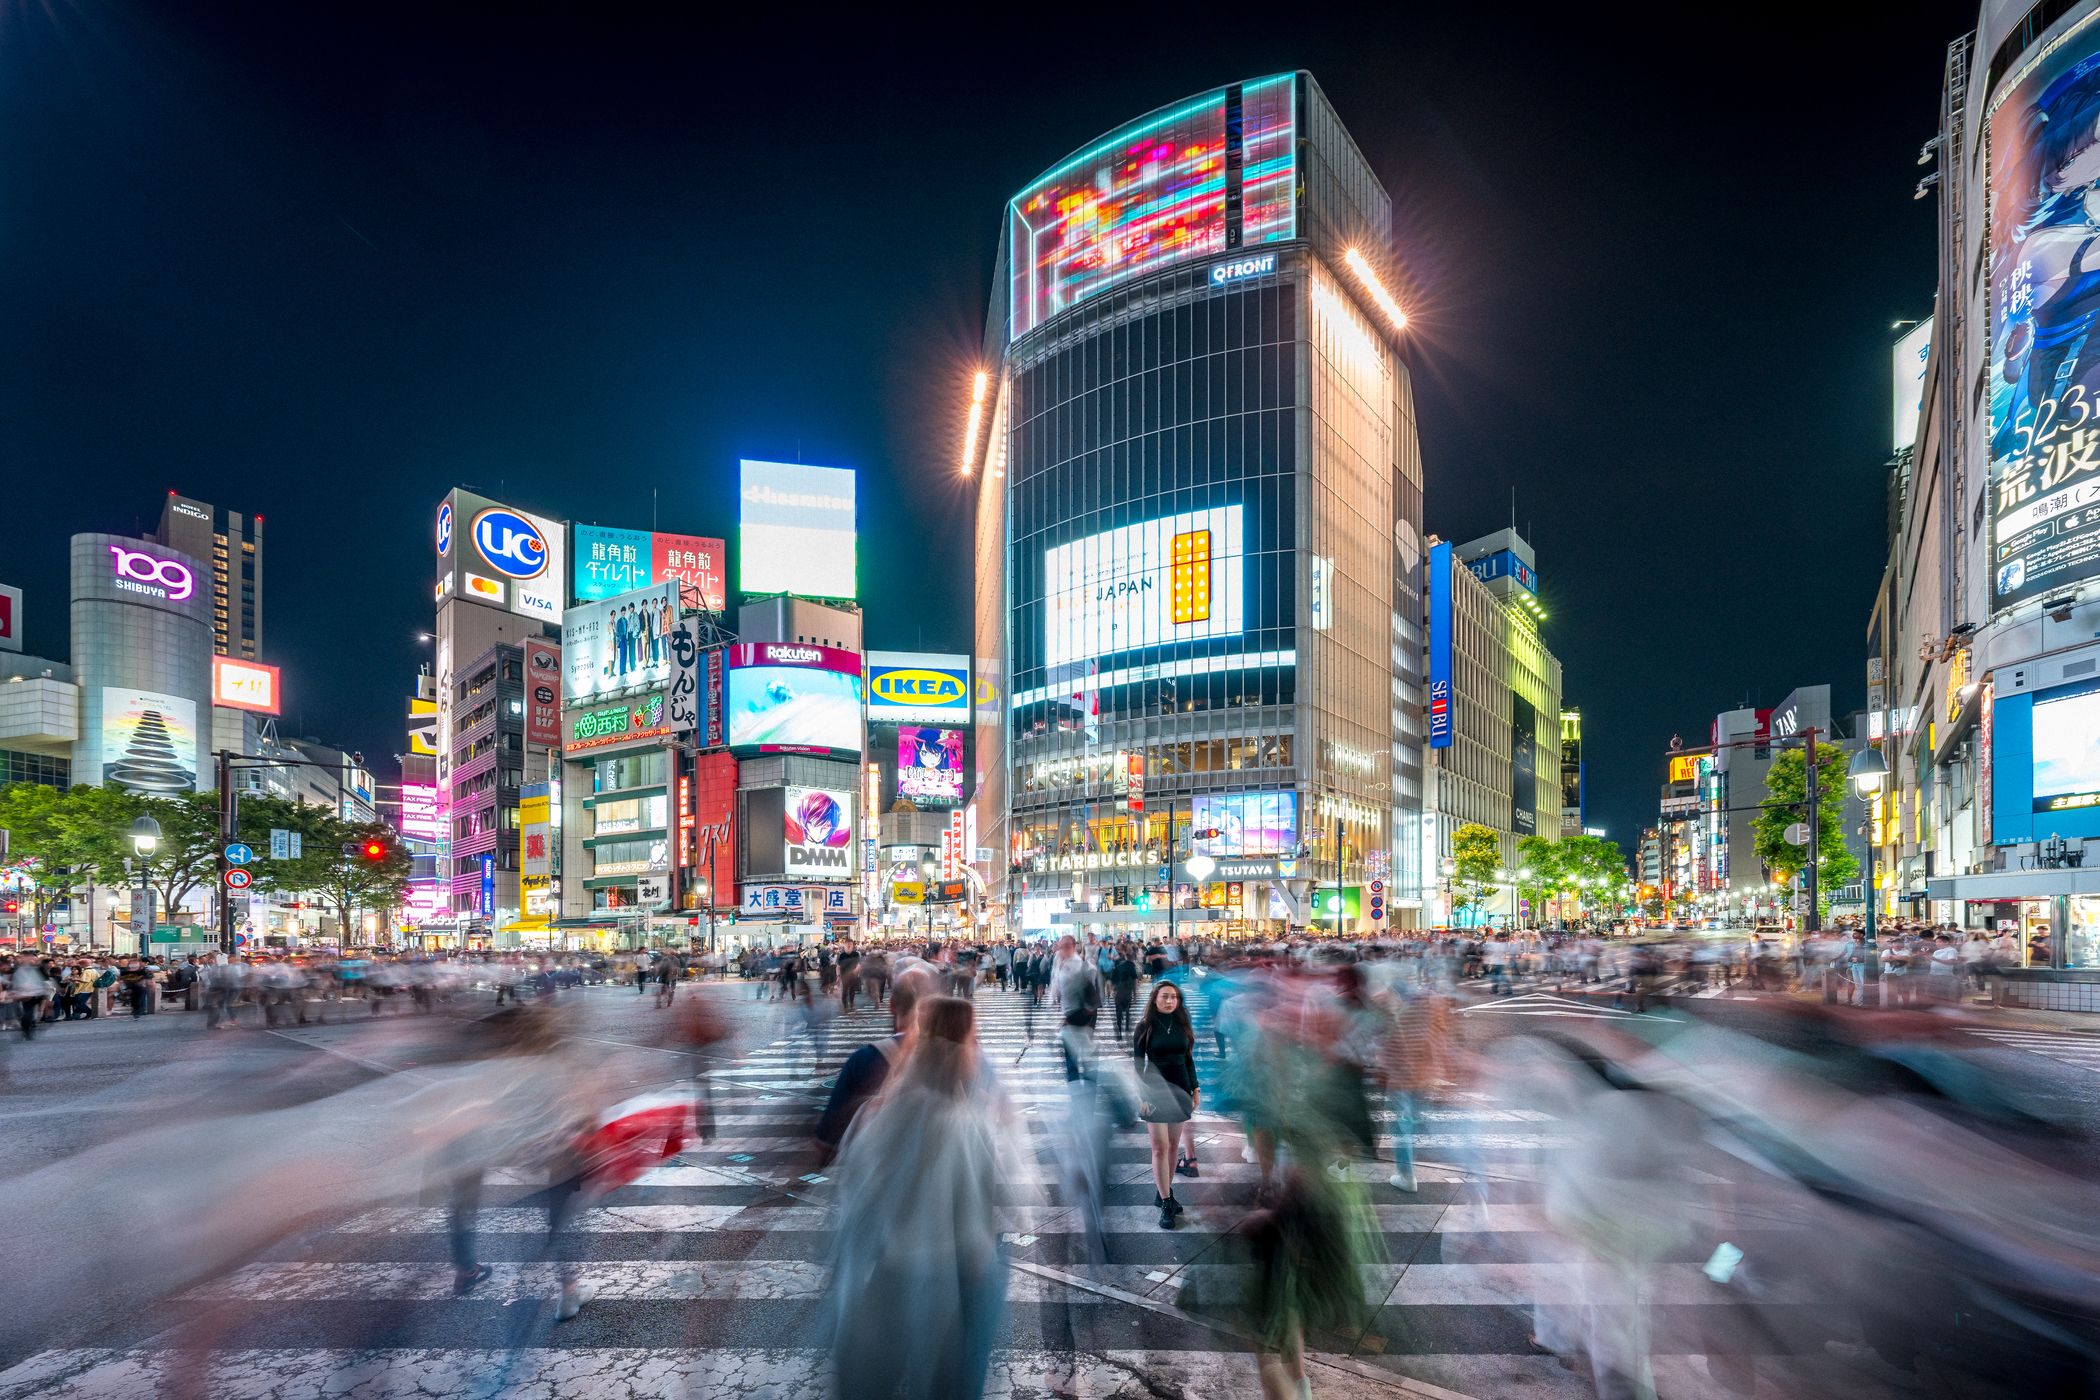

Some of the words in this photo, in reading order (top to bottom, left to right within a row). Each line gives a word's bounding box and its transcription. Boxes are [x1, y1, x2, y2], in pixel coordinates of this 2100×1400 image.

[2013, 384, 2090, 456] 5/23
[173, 505, 209, 520] INDIGO
[181, 503, 201, 512] HOTEL
[482, 520, 543, 566] UC
[591, 542, 637, 564] 龍角散
[668, 549, 711, 570] 龍角散
[110, 546, 193, 600] 109
[585, 561, 645, 583] ダイレクト
[115, 579, 166, 598] SHIBUYA
[1096, 576, 1152, 601] JAPAN
[1396, 577, 1419, 601] TSUTAYA
[523, 594, 553, 611] VISA
[767, 645, 822, 662] Rakuten
[671, 622, 696, 728] もんじゃ
[880, 678, 960, 696] IKEA
[535, 706, 554, 717] B1F
[1432, 680, 1447, 737] SEIBU
[535, 716, 554, 728] B2F
[597, 714, 628, 735] 西村
[1776, 705, 1798, 736] ZAR
[1515, 808, 1535, 824] CHANEL
[701, 811, 732, 865] クスリ
[790, 847, 847, 867] DMM
[1036, 850, 1158, 872] STARBUCKS
[1220, 865, 1273, 875] TSUTAYA
[749, 889, 845, 908] 大盛堂店
